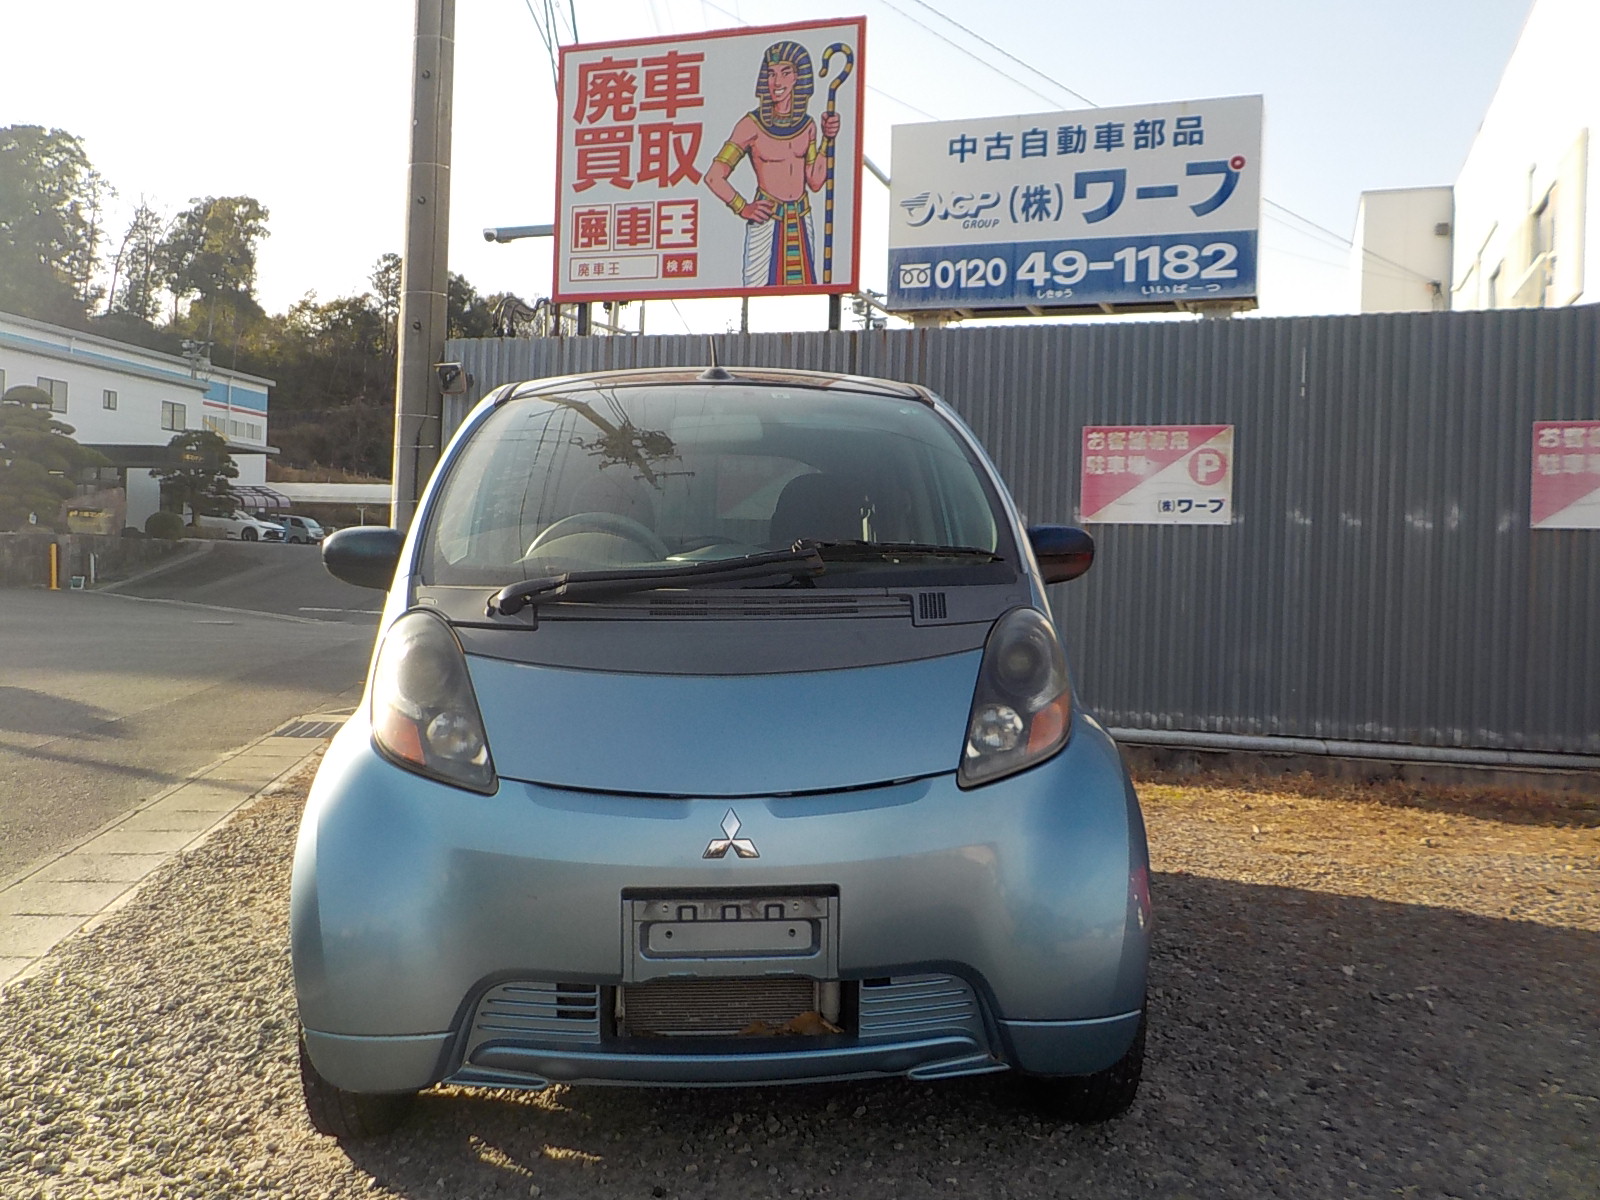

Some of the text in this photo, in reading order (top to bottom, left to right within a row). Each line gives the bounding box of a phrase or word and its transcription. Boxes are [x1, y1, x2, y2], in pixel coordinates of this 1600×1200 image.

[573, 50, 705, 124] 廃車
[572, 121, 703, 193] 買取
[948, 115, 1205, 164] 中古自動車部品
[962, 218, 1000, 230] GROUP
[577, 261, 620, 277] 廃車王
[666, 260, 694, 273] 検索
[934, 242, 1238, 289] 0120 49-1182
